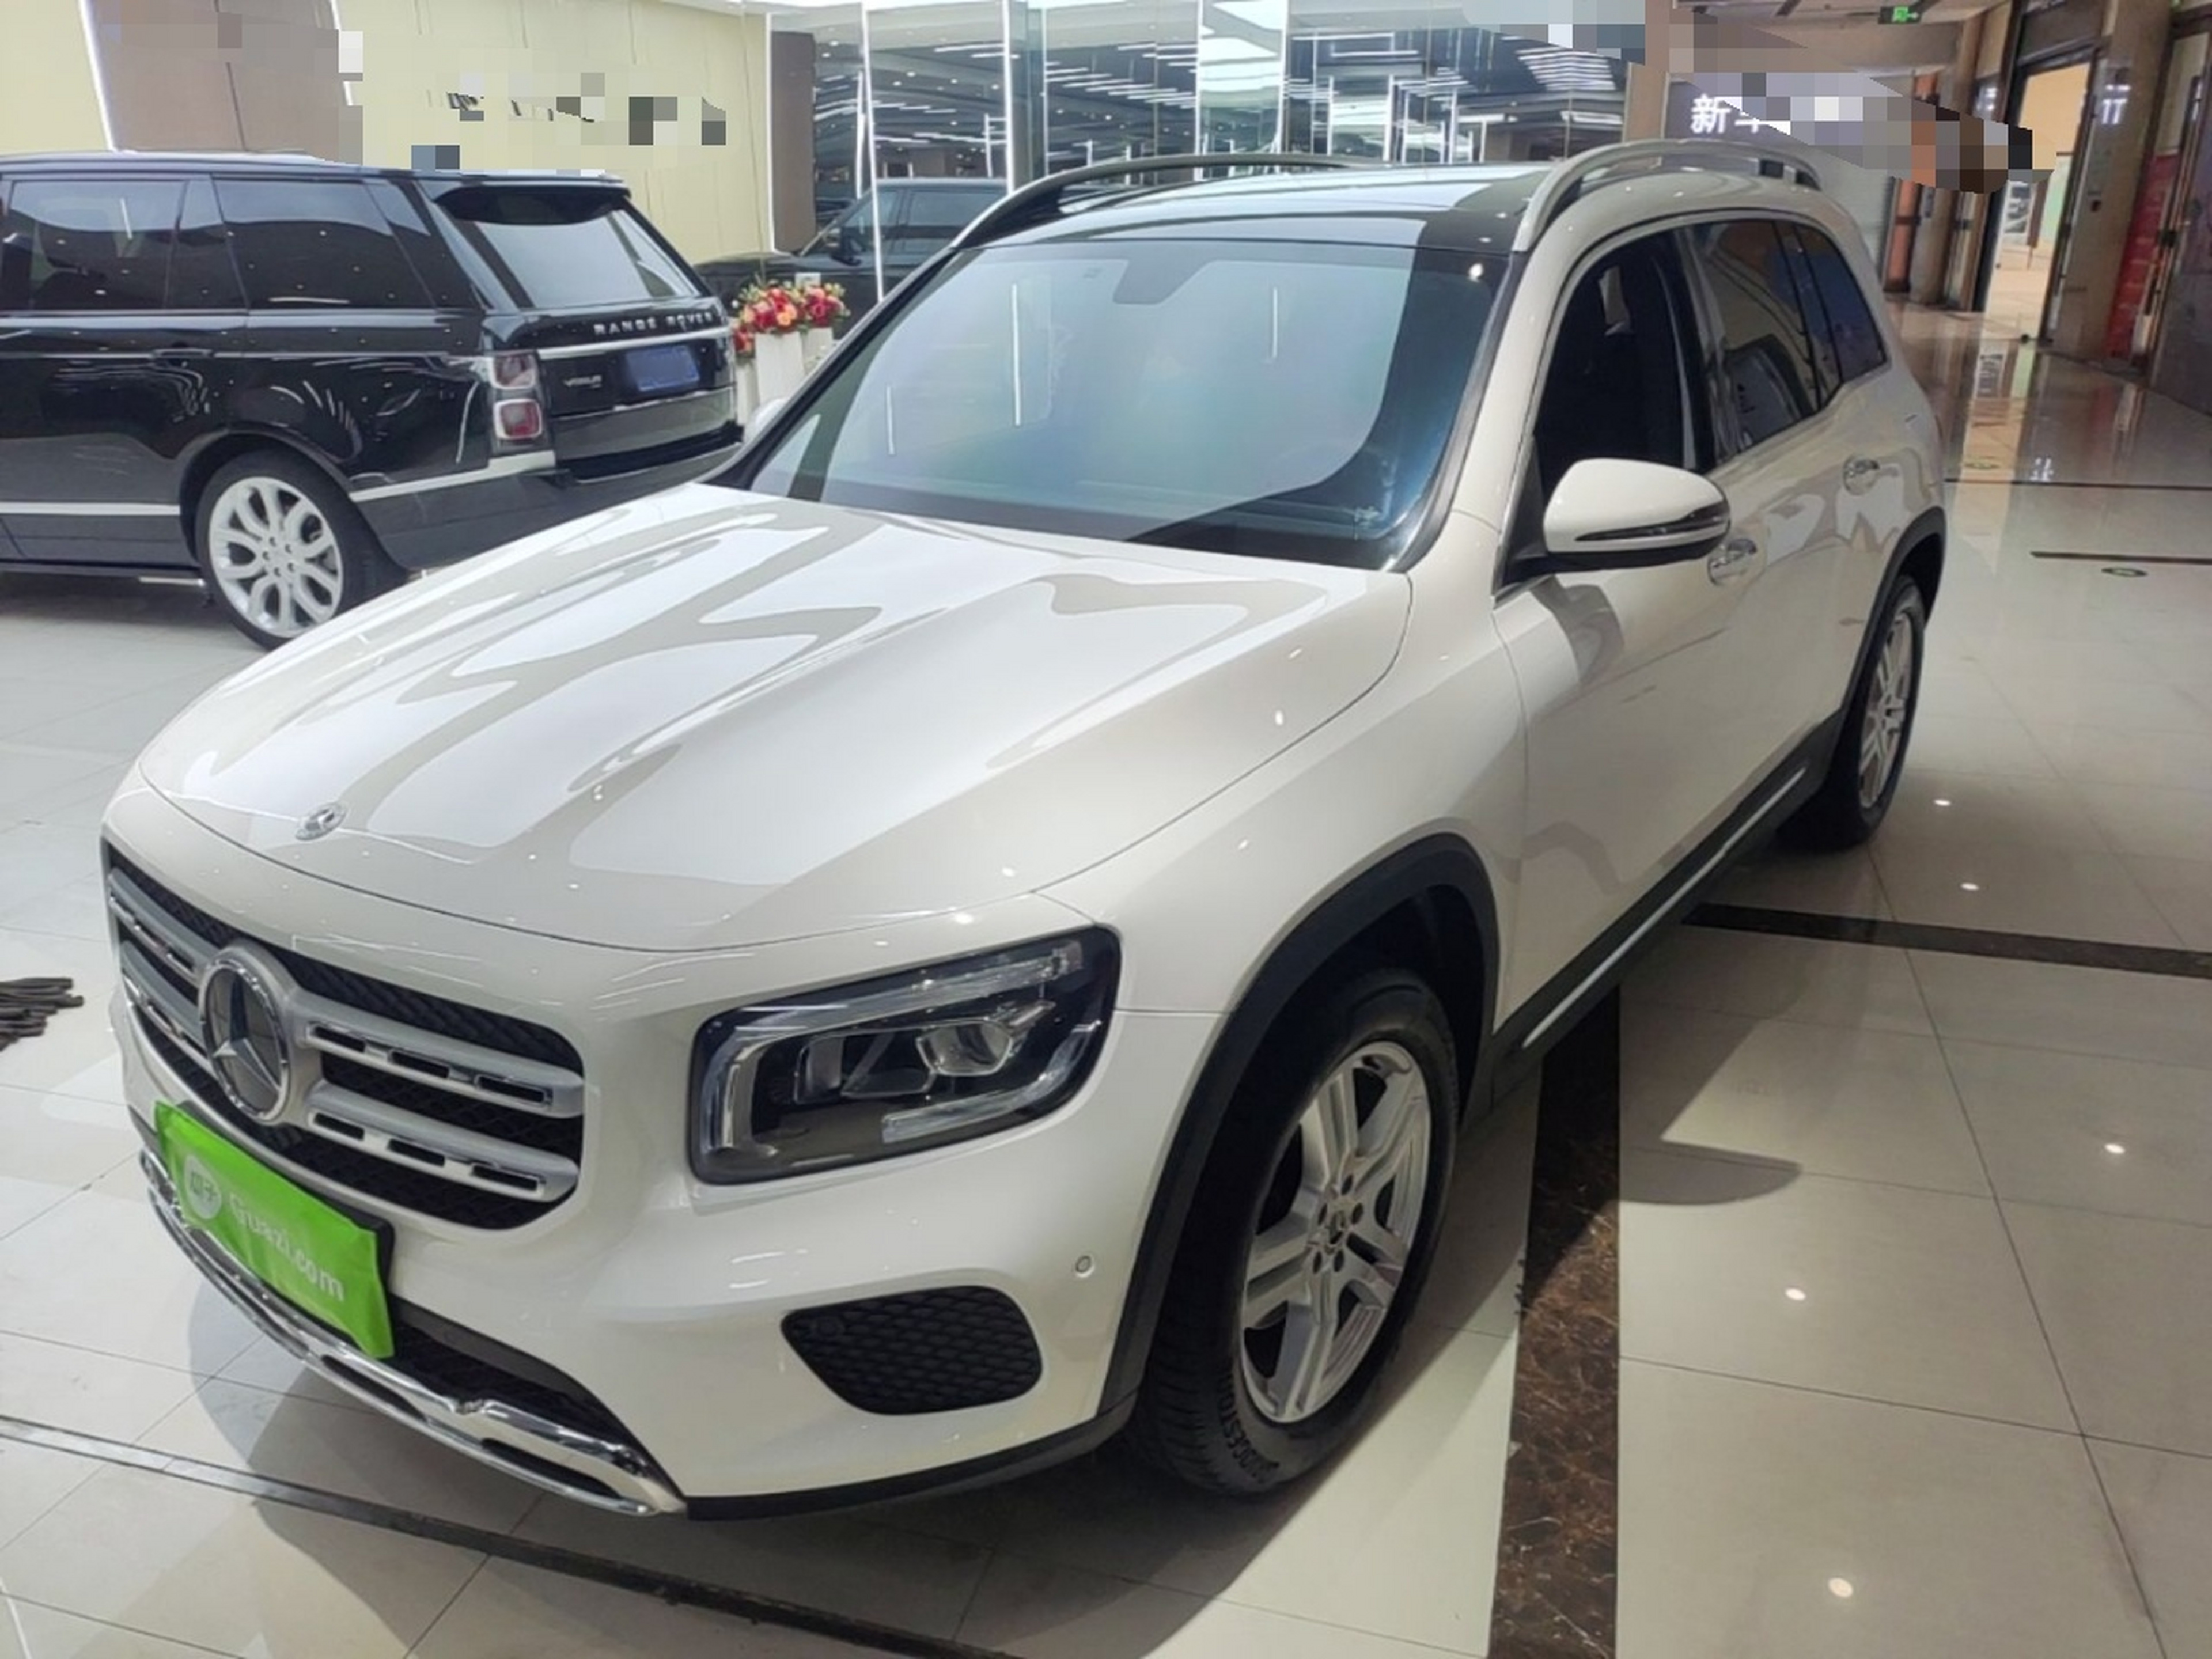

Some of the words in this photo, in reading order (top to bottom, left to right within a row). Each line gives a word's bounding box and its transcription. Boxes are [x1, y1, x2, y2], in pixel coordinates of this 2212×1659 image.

[593, 316, 657, 335] RANGE
[665, 311, 713, 329] ROVER
[1215, 1355, 1279, 1484] DGESTONE
